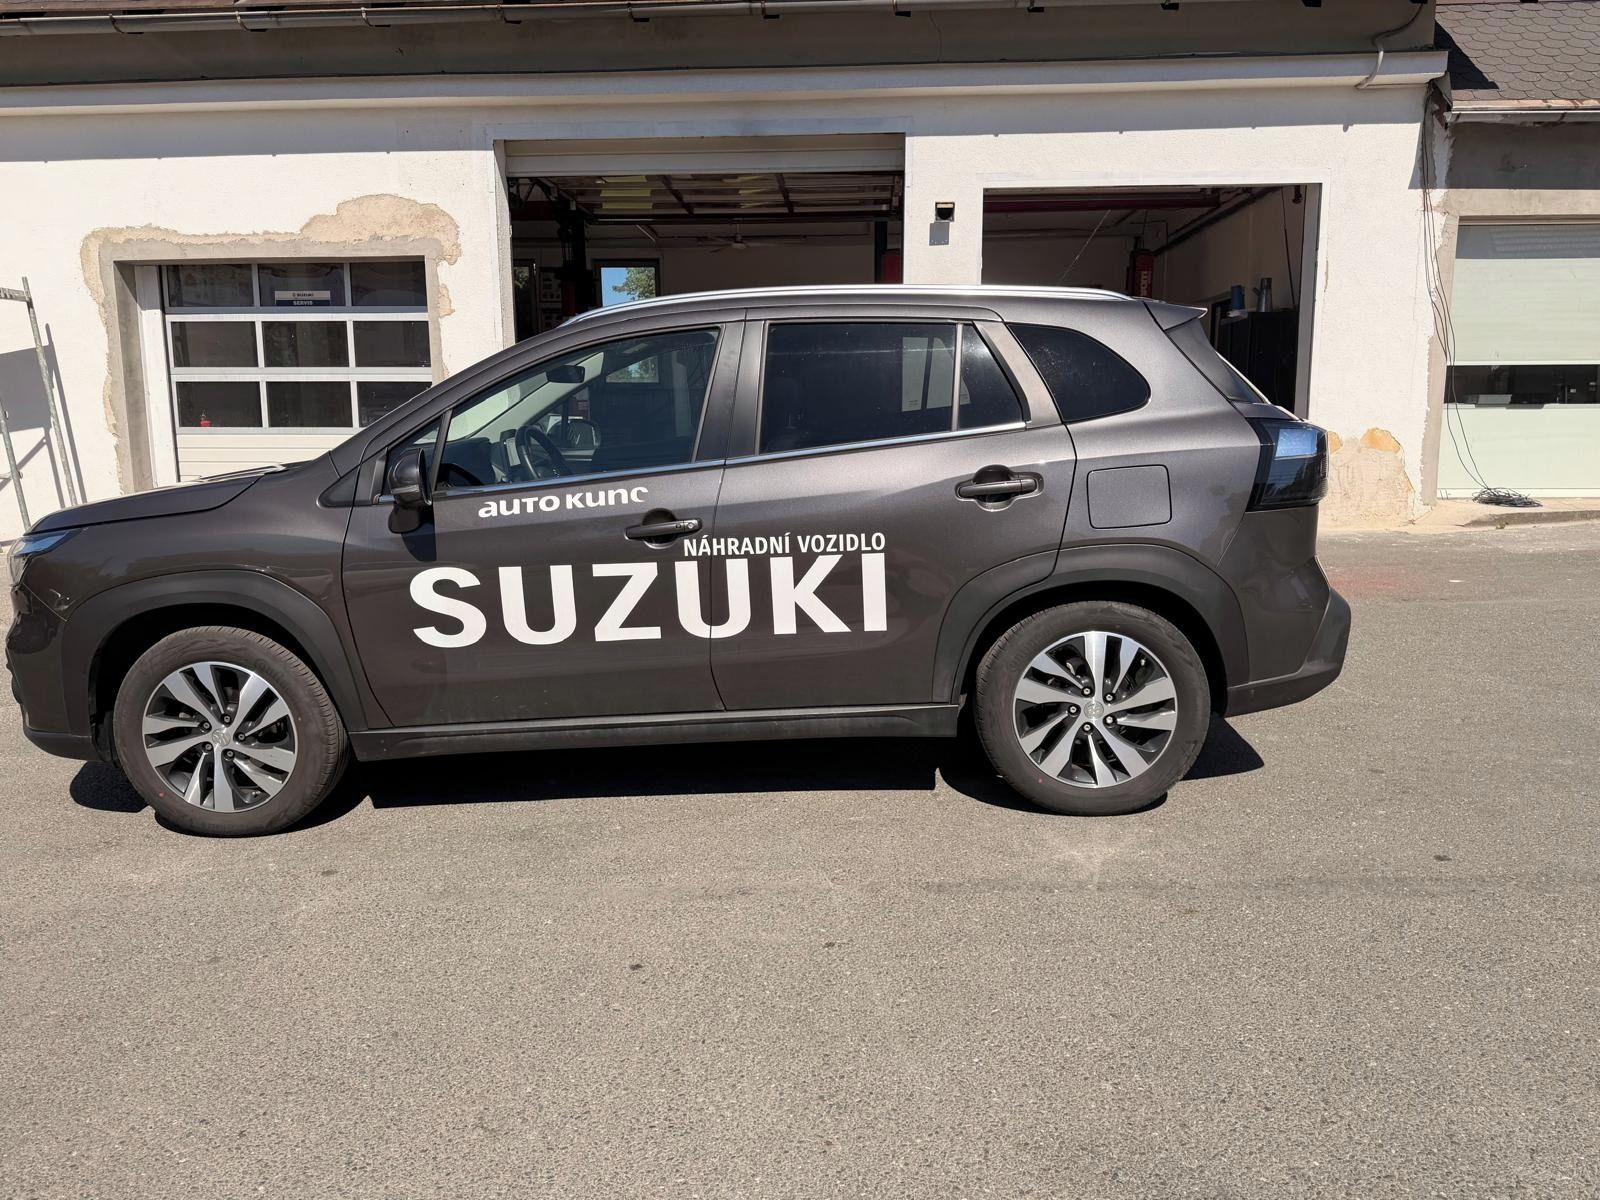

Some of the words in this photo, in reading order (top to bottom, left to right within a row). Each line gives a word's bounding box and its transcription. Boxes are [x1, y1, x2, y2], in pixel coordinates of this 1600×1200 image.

[683, 532, 791, 557] NÁHRADNÍ
[796, 532, 886, 553] VOZIDLO
[409, 552, 888, 648] SUZUKI
